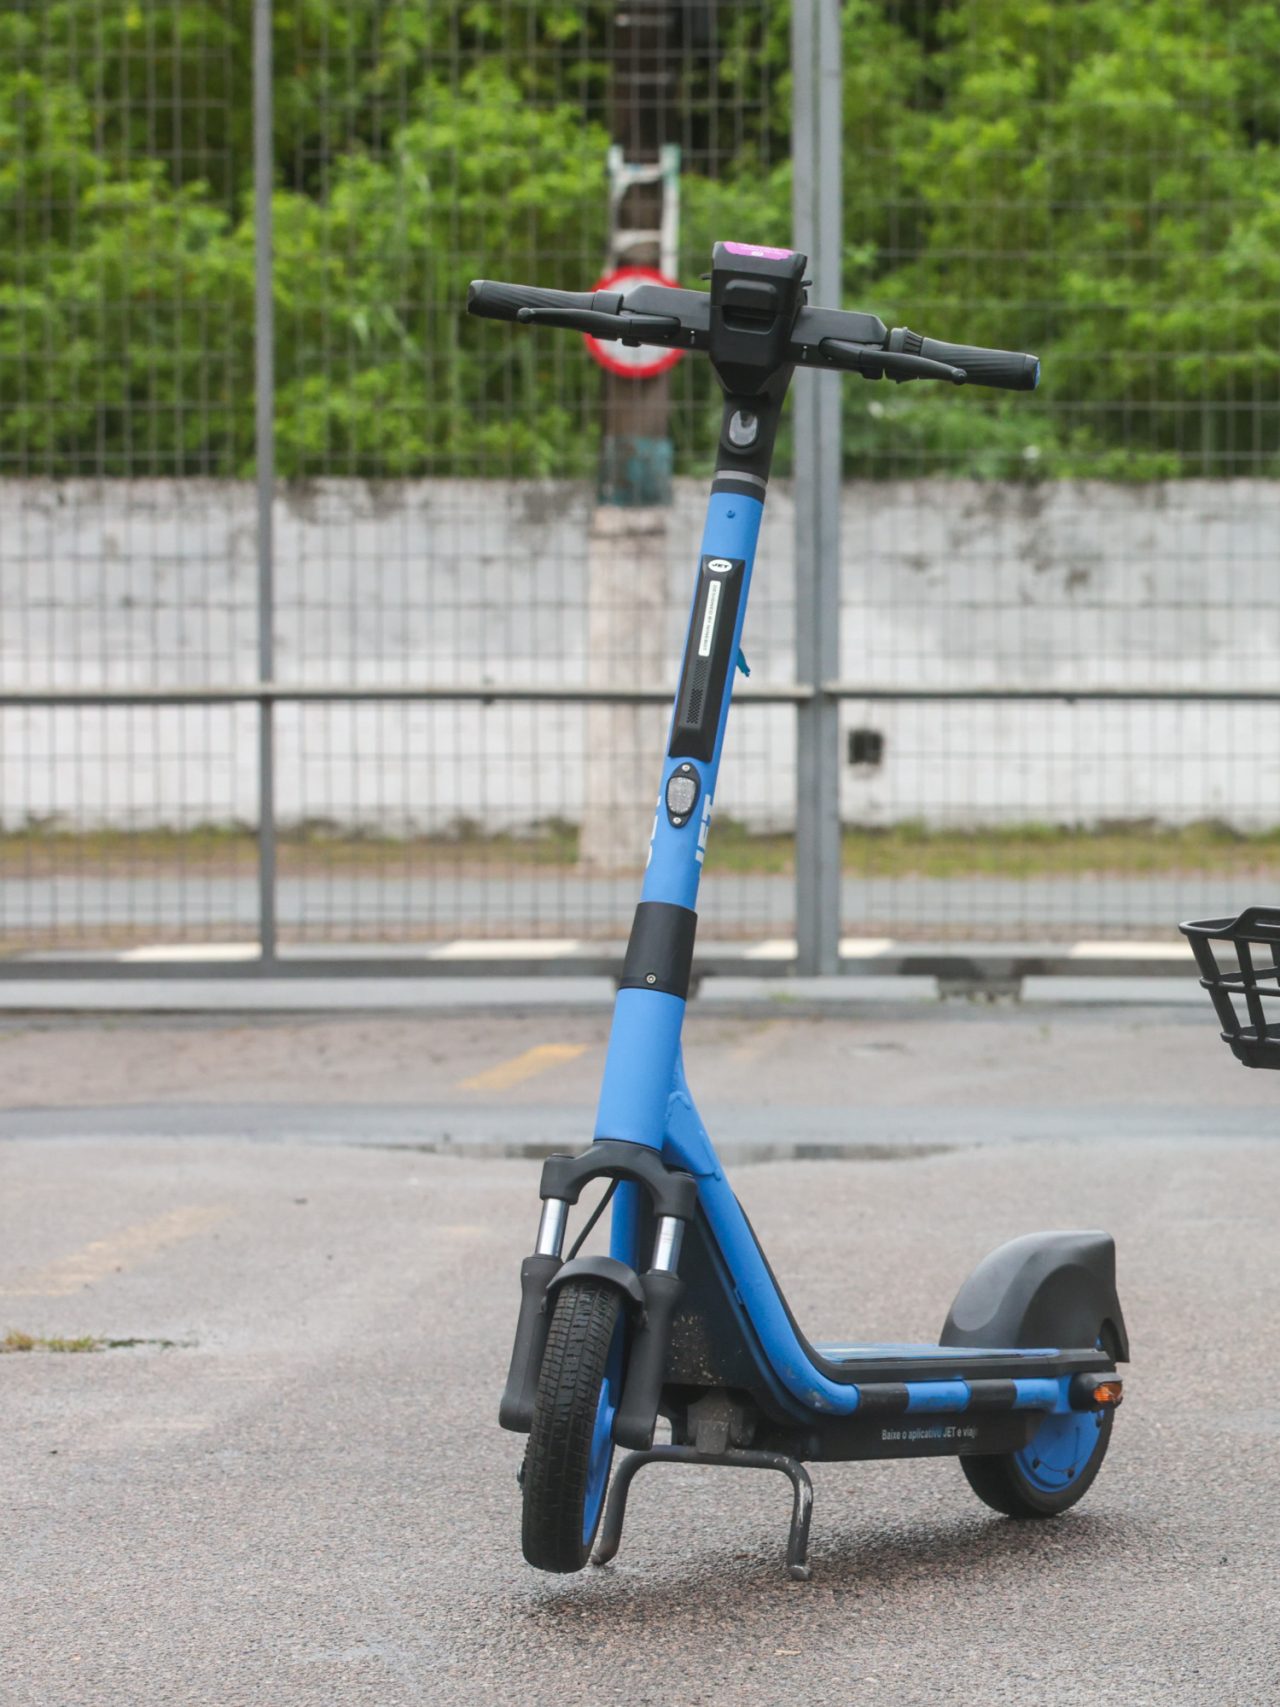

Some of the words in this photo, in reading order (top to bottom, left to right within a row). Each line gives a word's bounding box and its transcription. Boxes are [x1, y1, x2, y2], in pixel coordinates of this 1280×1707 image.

[881, 1428, 900, 1440] Baixe
[901, 1430, 907, 1440] o
[908, 1427, 941, 1442] aplicativo
[943, 1426, 957, 1438] JET
[957, 1428, 962, 1437] e
